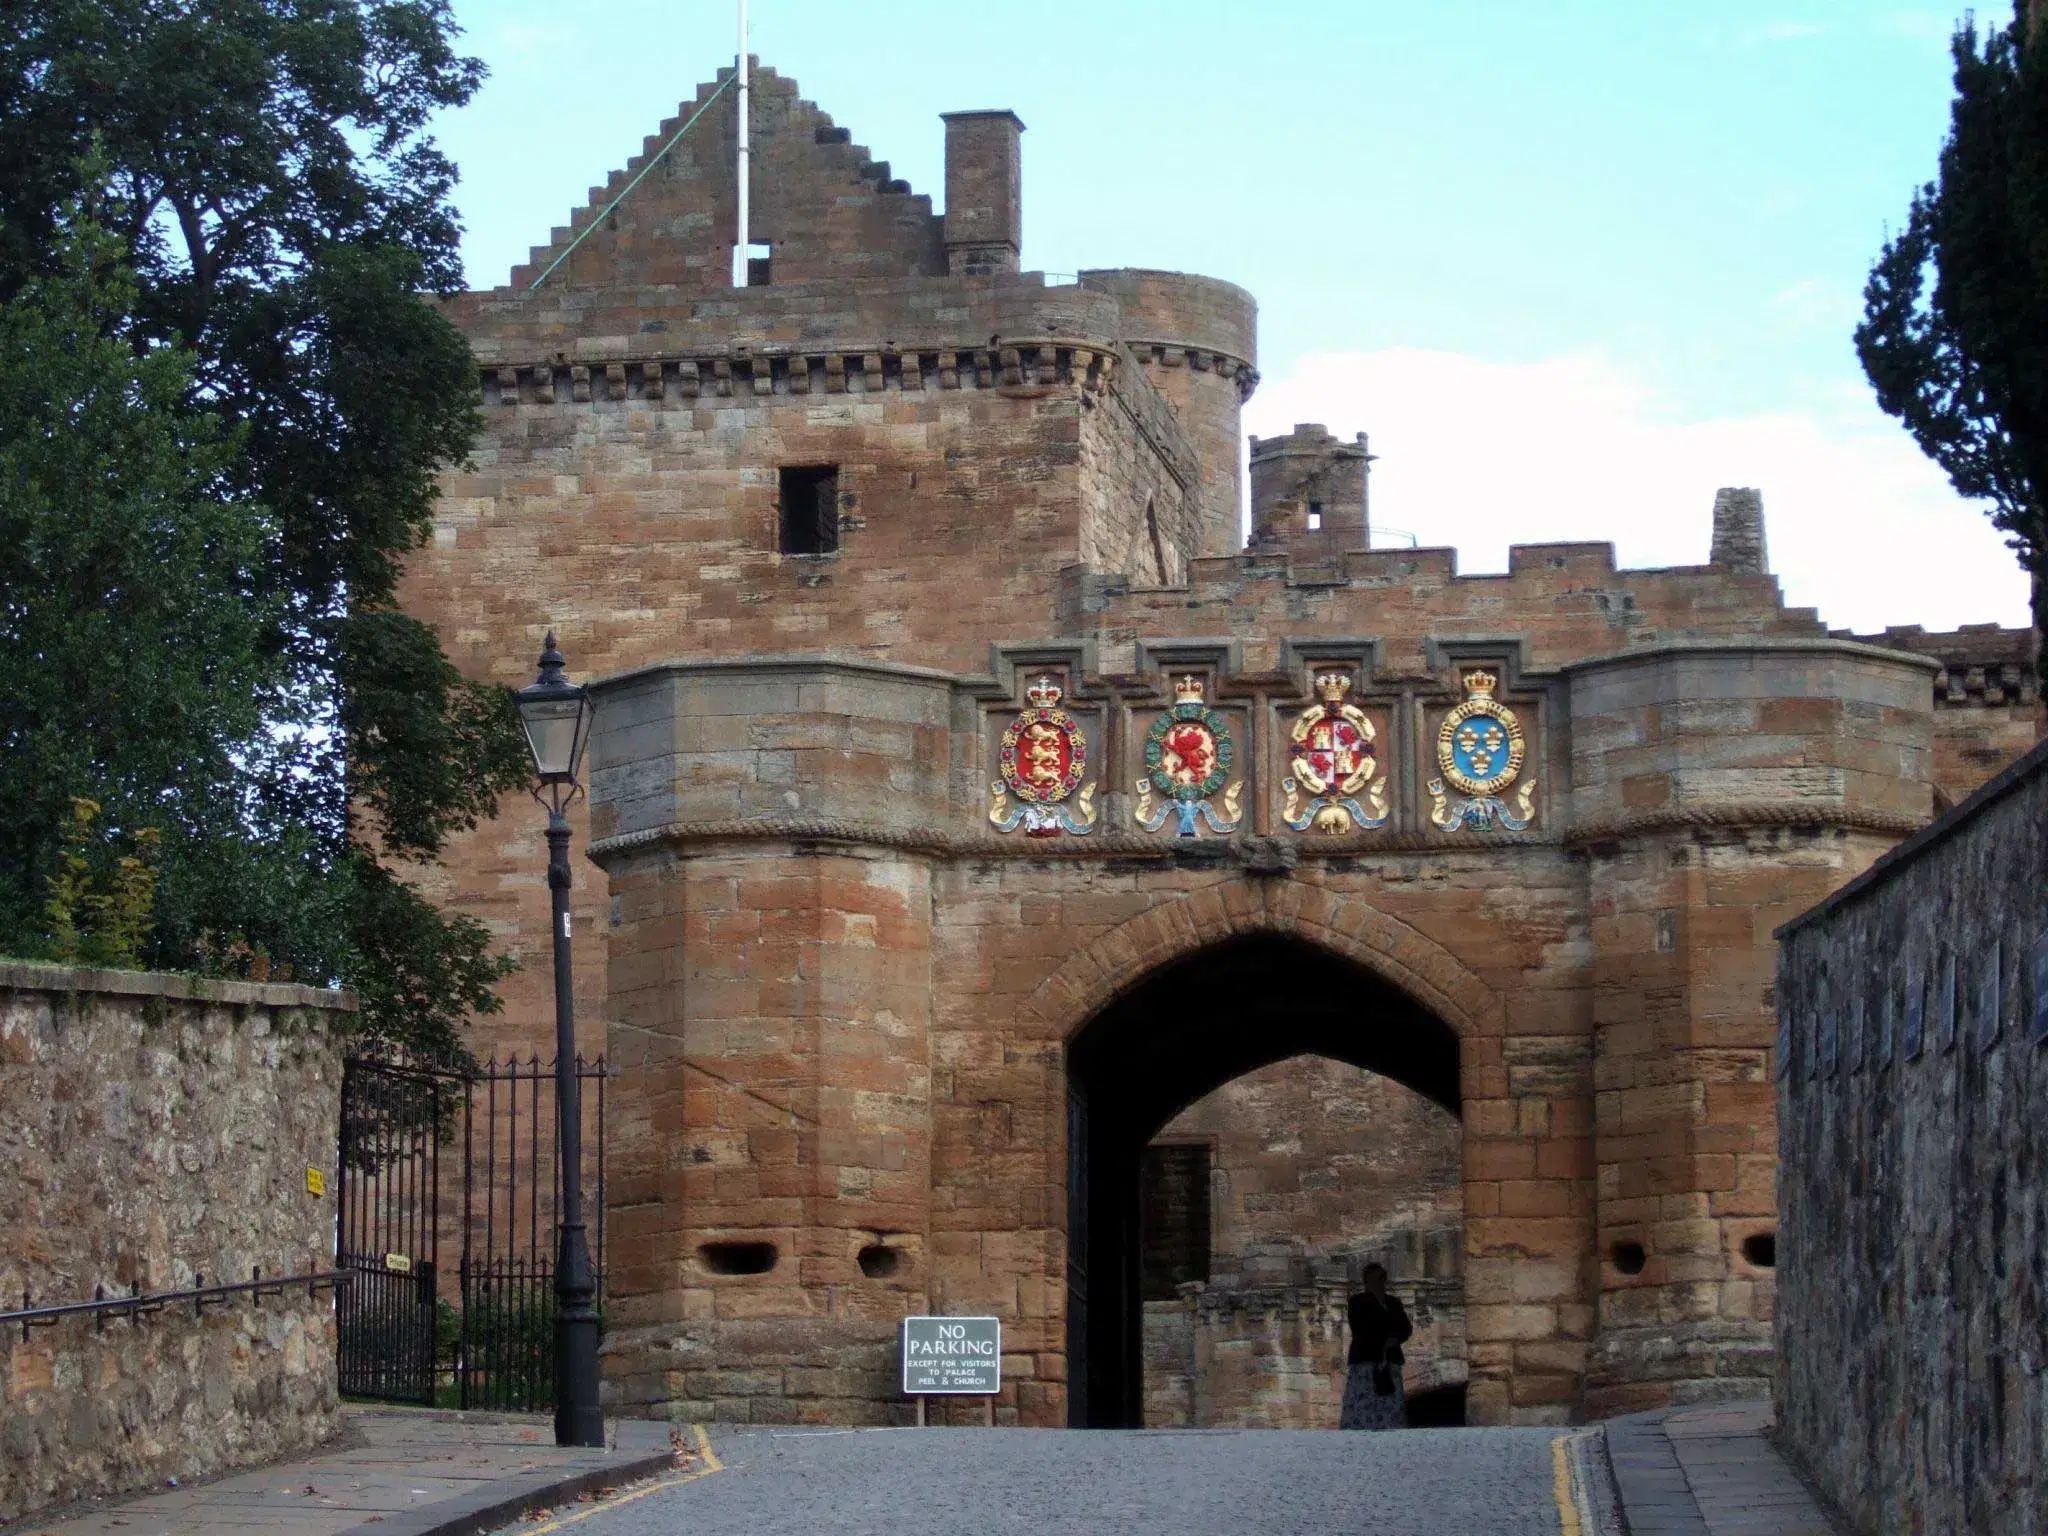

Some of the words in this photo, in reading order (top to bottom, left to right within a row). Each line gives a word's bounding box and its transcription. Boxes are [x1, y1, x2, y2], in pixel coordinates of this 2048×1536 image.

[939, 1325, 965, 1339] NO
[910, 1340, 994, 1355] PARKING
[918, 1377, 936, 1385] PEEL
[941, 1377, 949, 1385] &
[954, 1377, 986, 1385] CHURCH
